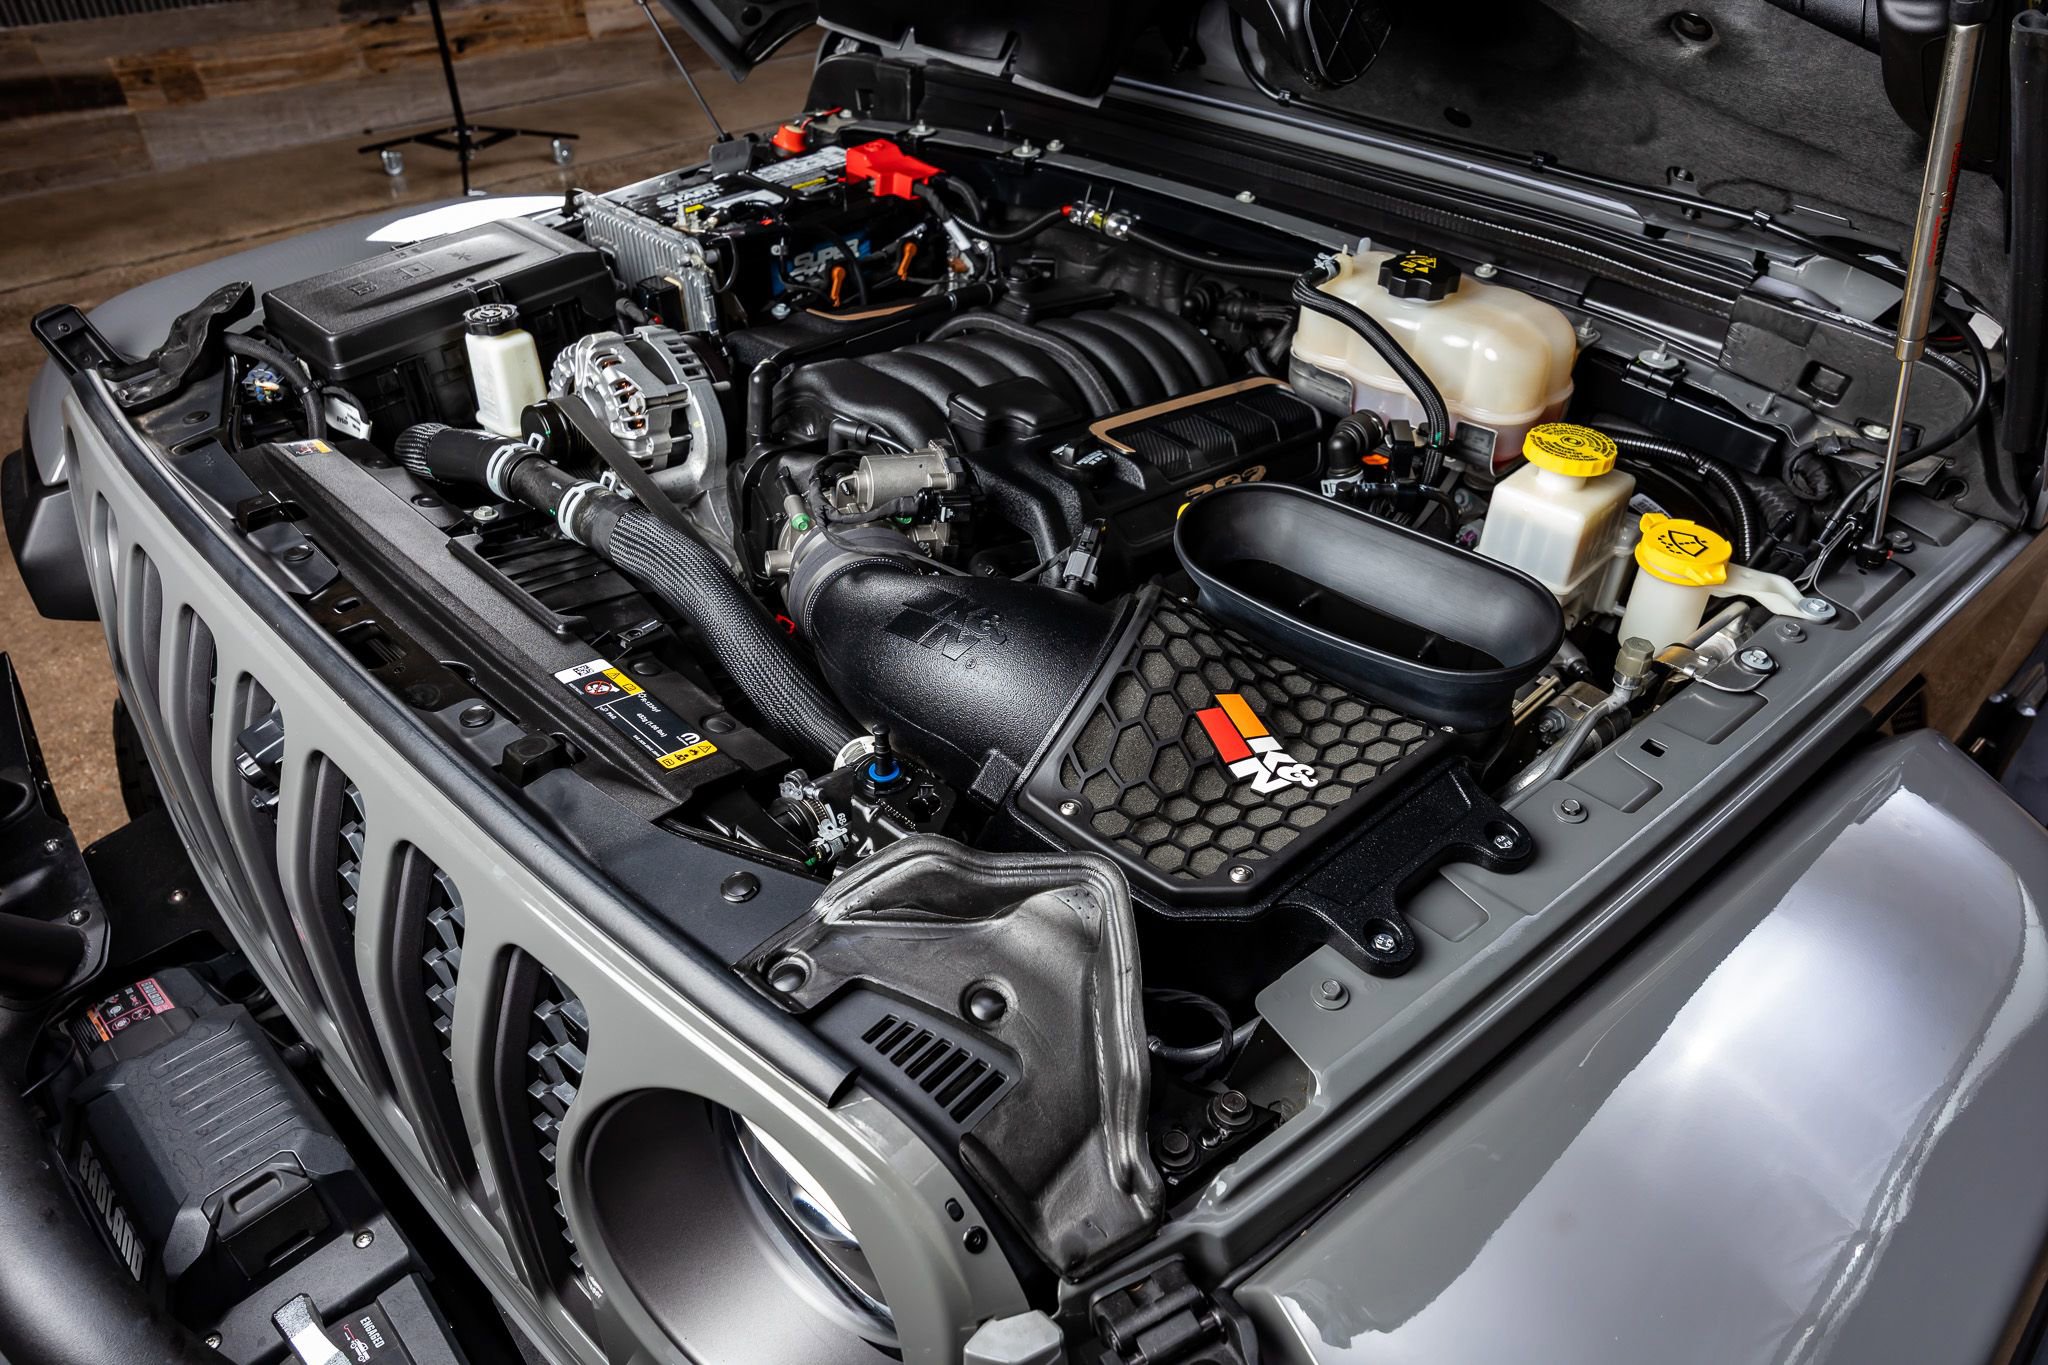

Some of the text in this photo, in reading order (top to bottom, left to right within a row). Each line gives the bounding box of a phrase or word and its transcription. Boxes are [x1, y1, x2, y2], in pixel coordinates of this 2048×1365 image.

[141, 981, 165, 1006] BADLAND
[79, 1141, 144, 1281] BADLAND
[360, 1316, 385, 1348] ENGAGED
